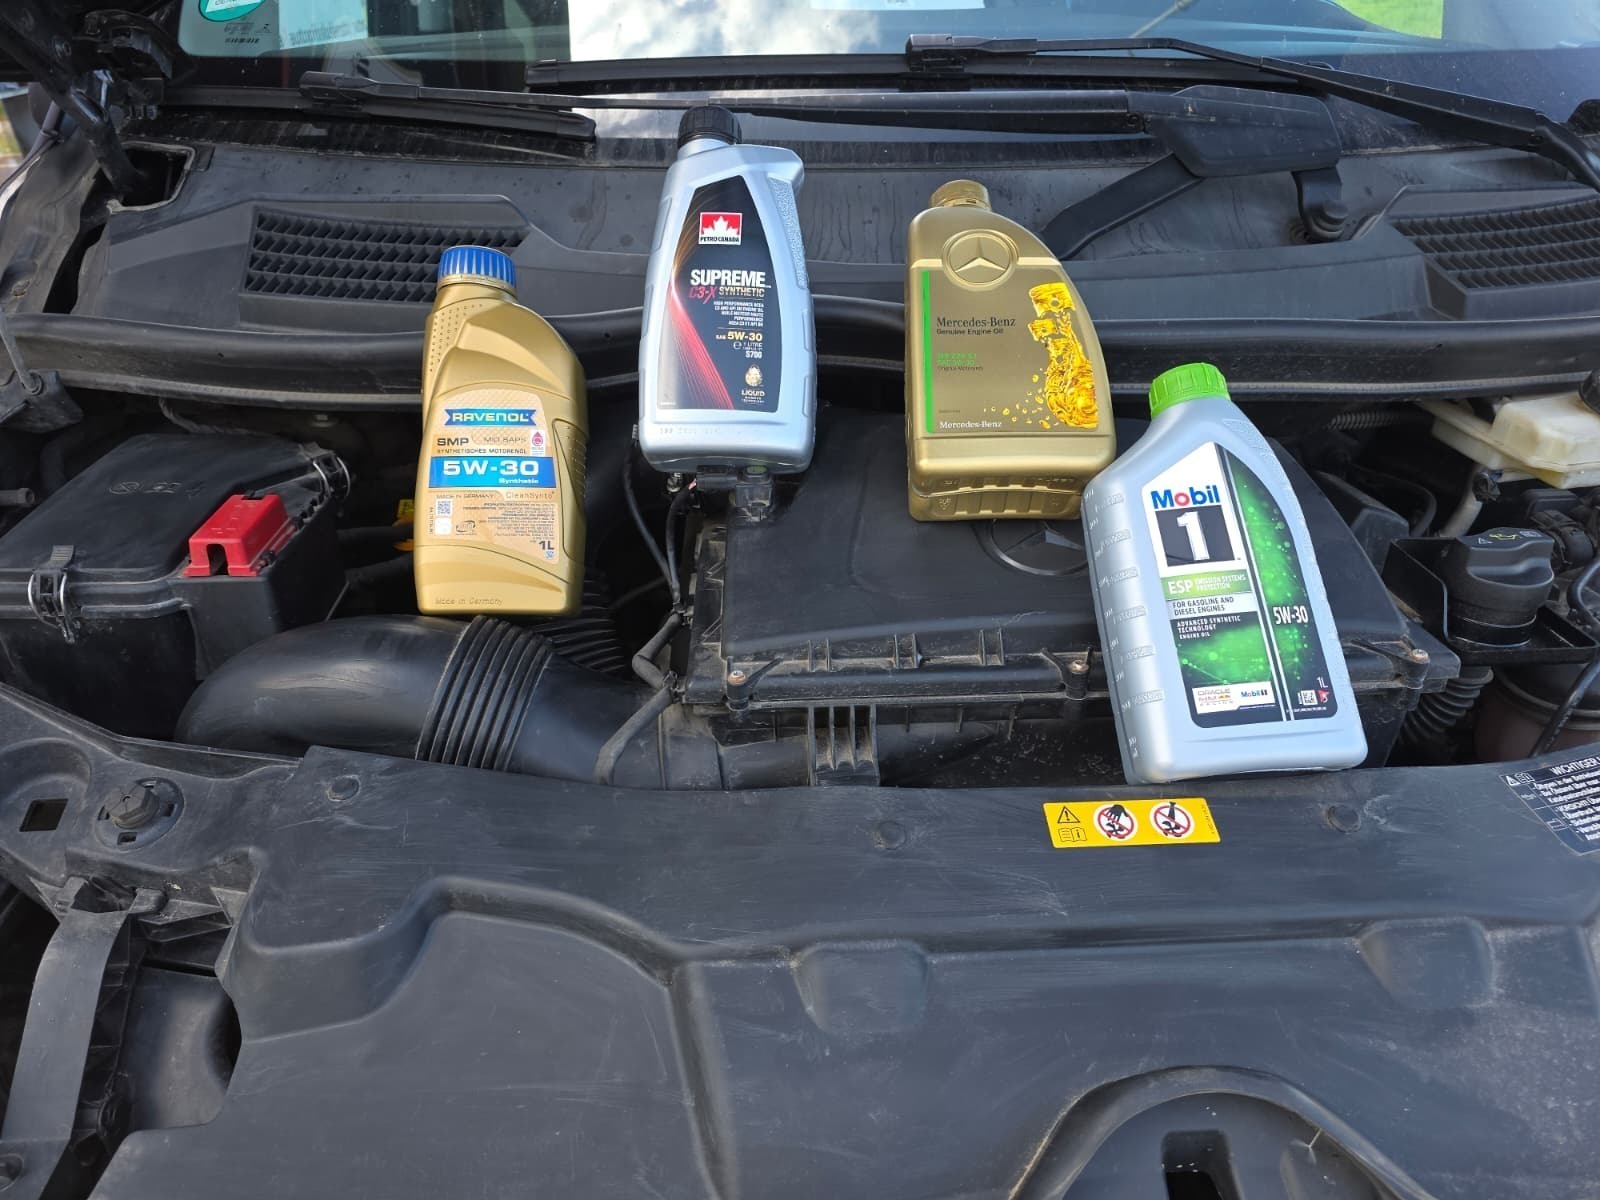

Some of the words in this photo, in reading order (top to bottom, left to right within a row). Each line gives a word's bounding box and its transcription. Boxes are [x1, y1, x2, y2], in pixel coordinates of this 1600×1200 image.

[690, 269, 766, 287] SUPREME
[689, 286, 717, 304] C3-X
[718, 286, 765, 297] SYNTHETIC
[936, 317, 1016, 328] Mercedes-Benz
[727, 331, 763, 341] 5W-30
[940, 421, 1002, 429] Mercedes-Benz
[437, 438, 469, 446] SMP
[443, 460, 539, 476] 5W-30
[1151, 485, 1220, 509] Mobil
[1177, 511, 1210, 561] 1
[539, 541, 554, 550] 1L
[1168, 580, 1193, 594] ESP
[1195, 576, 1221, 585] EMISSION
[1221, 574, 1246, 583] SYSTEMS
[1172, 601, 1186, 609] FOR
[1187, 598, 1218, 607] GASOLINE
[1220, 596, 1234, 605] AND
[1174, 606, 1197, 616] DIESEL
[1198, 604, 1225, 614] ENGINES
[1273, 605, 1309, 625] 5W-30
[1177, 617, 1208, 627] ADVANCED
[1209, 615, 1241, 624] SYNTHETIC
[1178, 624, 1217, 634] TECHNOLOGY
[1316, 677, 1329, 689] 1L
[1197, 688, 1230, 696] ORACLE
[1240, 690, 1261, 698] Mobil
[1550, 757, 1597, 775] WICHTIGER
